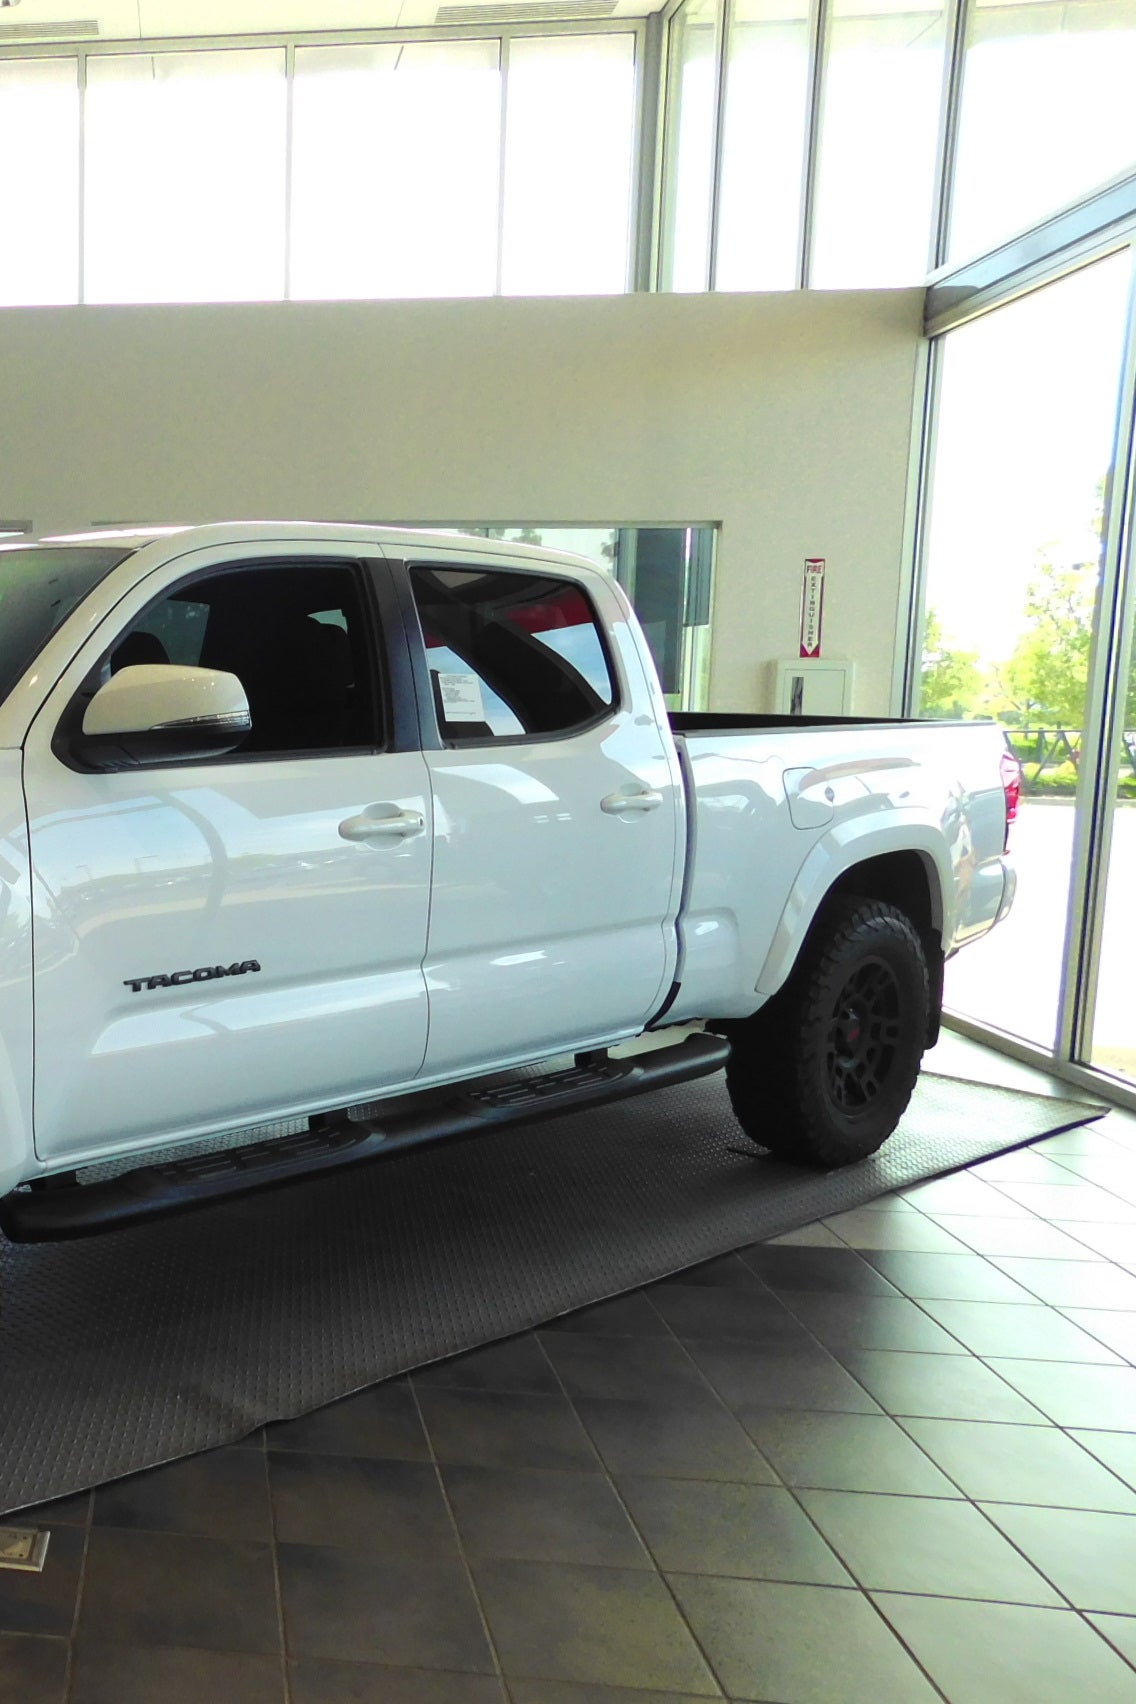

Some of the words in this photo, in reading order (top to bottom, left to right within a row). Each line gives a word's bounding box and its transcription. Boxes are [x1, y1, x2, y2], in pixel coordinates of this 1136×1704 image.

[806, 565, 822, 574] FIRE
[807, 576, 817, 648] EXTINGUISHER
[123, 959, 261, 992] TACOMA
